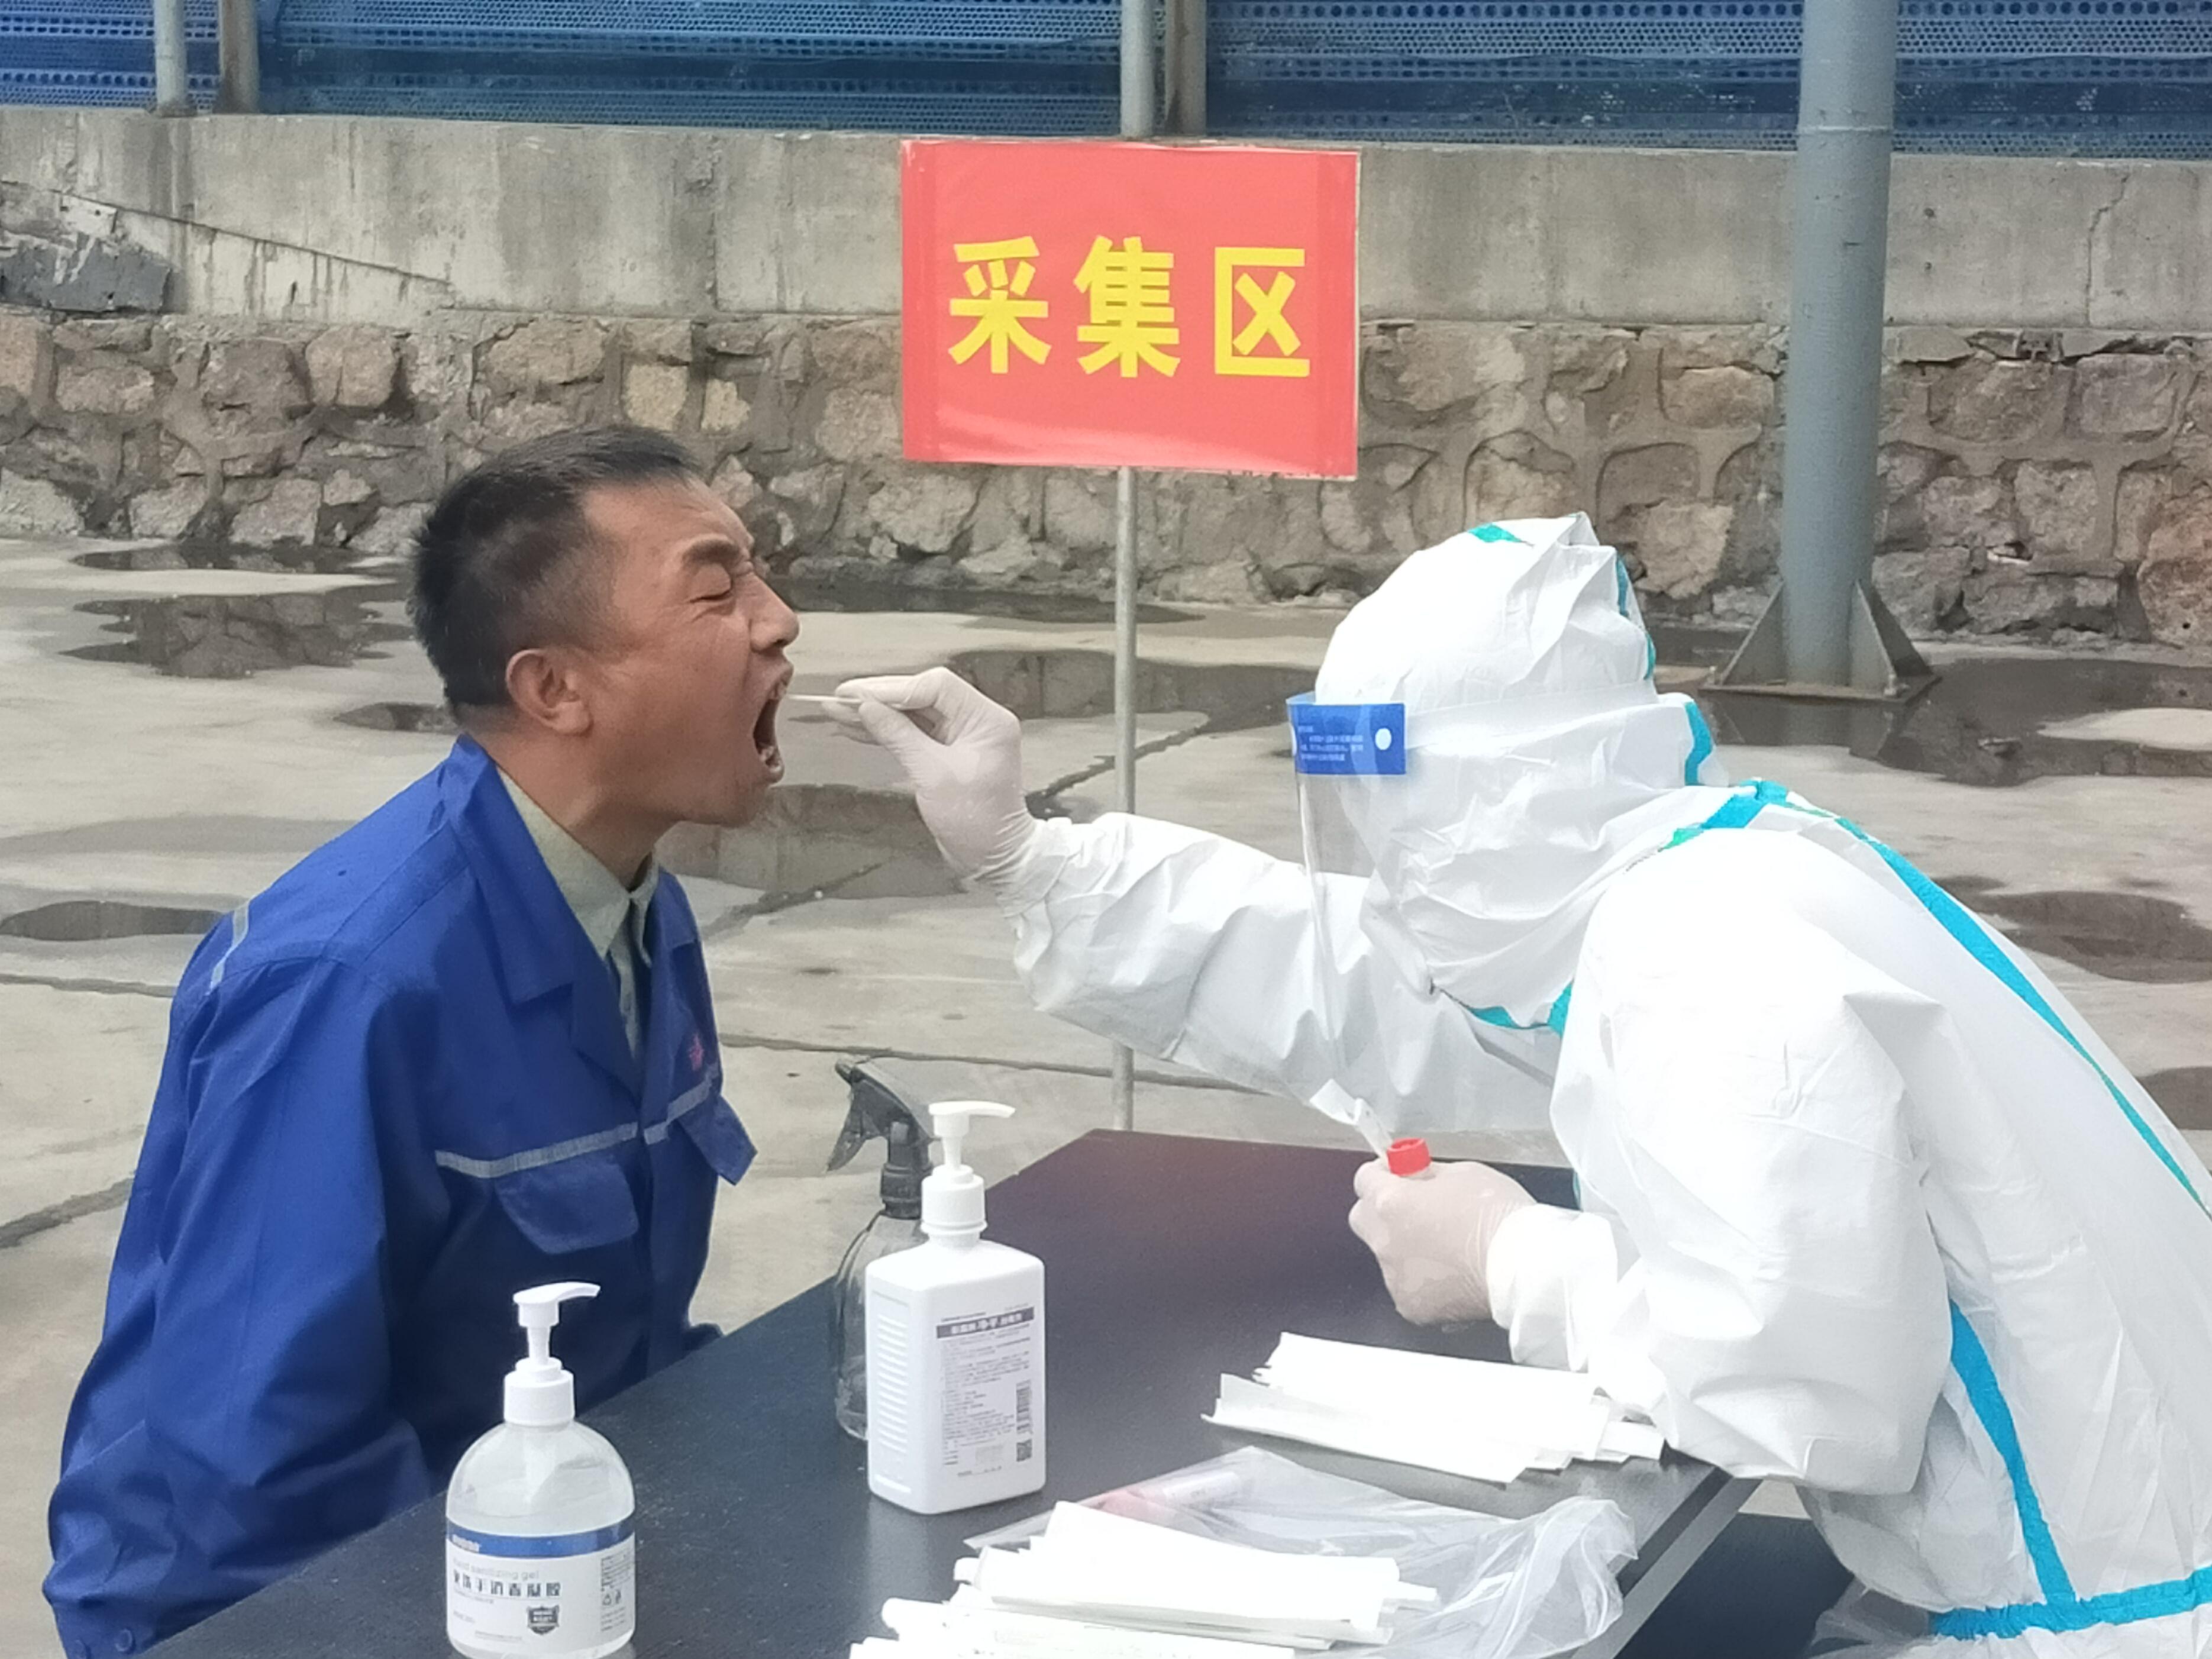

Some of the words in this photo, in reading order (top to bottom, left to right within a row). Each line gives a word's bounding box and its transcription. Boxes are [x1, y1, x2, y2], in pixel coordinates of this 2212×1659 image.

[948, 235, 1310, 378] 采集区
[521, 1571, 538, 1581] gel
